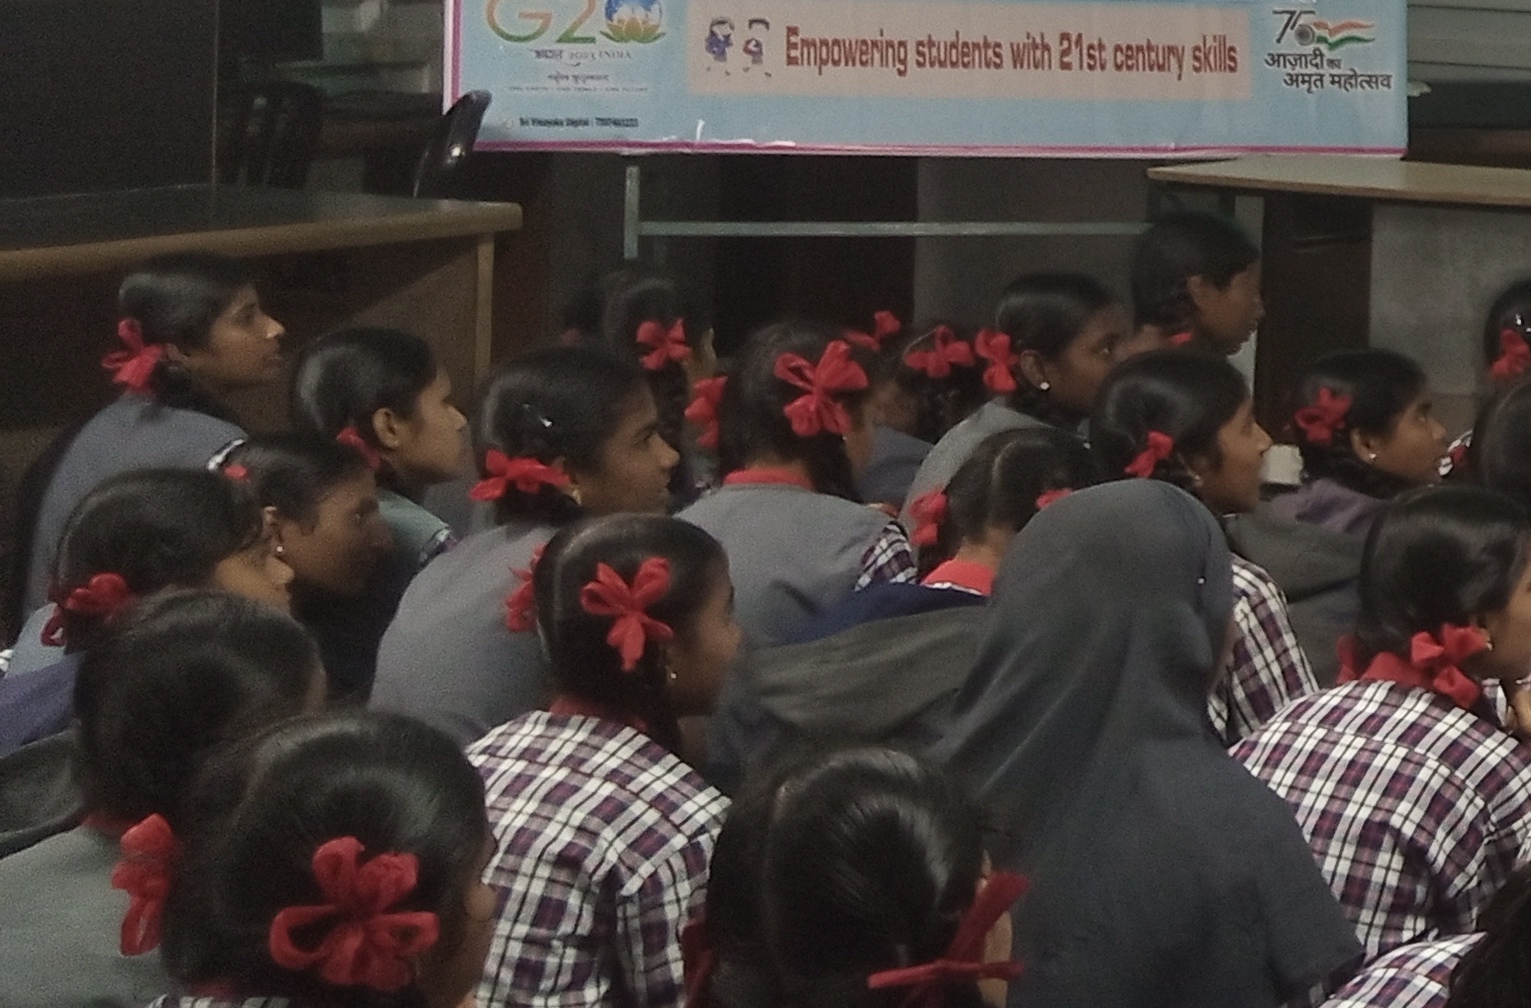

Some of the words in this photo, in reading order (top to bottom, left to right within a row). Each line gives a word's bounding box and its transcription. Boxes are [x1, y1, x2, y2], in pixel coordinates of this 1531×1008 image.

[786, 25, 908, 77] Empowering
[915, 29, 1004, 70] students
[1010, 31, 1052, 70] with
[1058, 31, 1107, 72] 21st
[1113, 38, 1185, 81] century
[1192, 34, 1238, 73] skills
[1283, 72, 1325, 93] अमृत
[1329, 68, 1393, 92] महोत्सव
